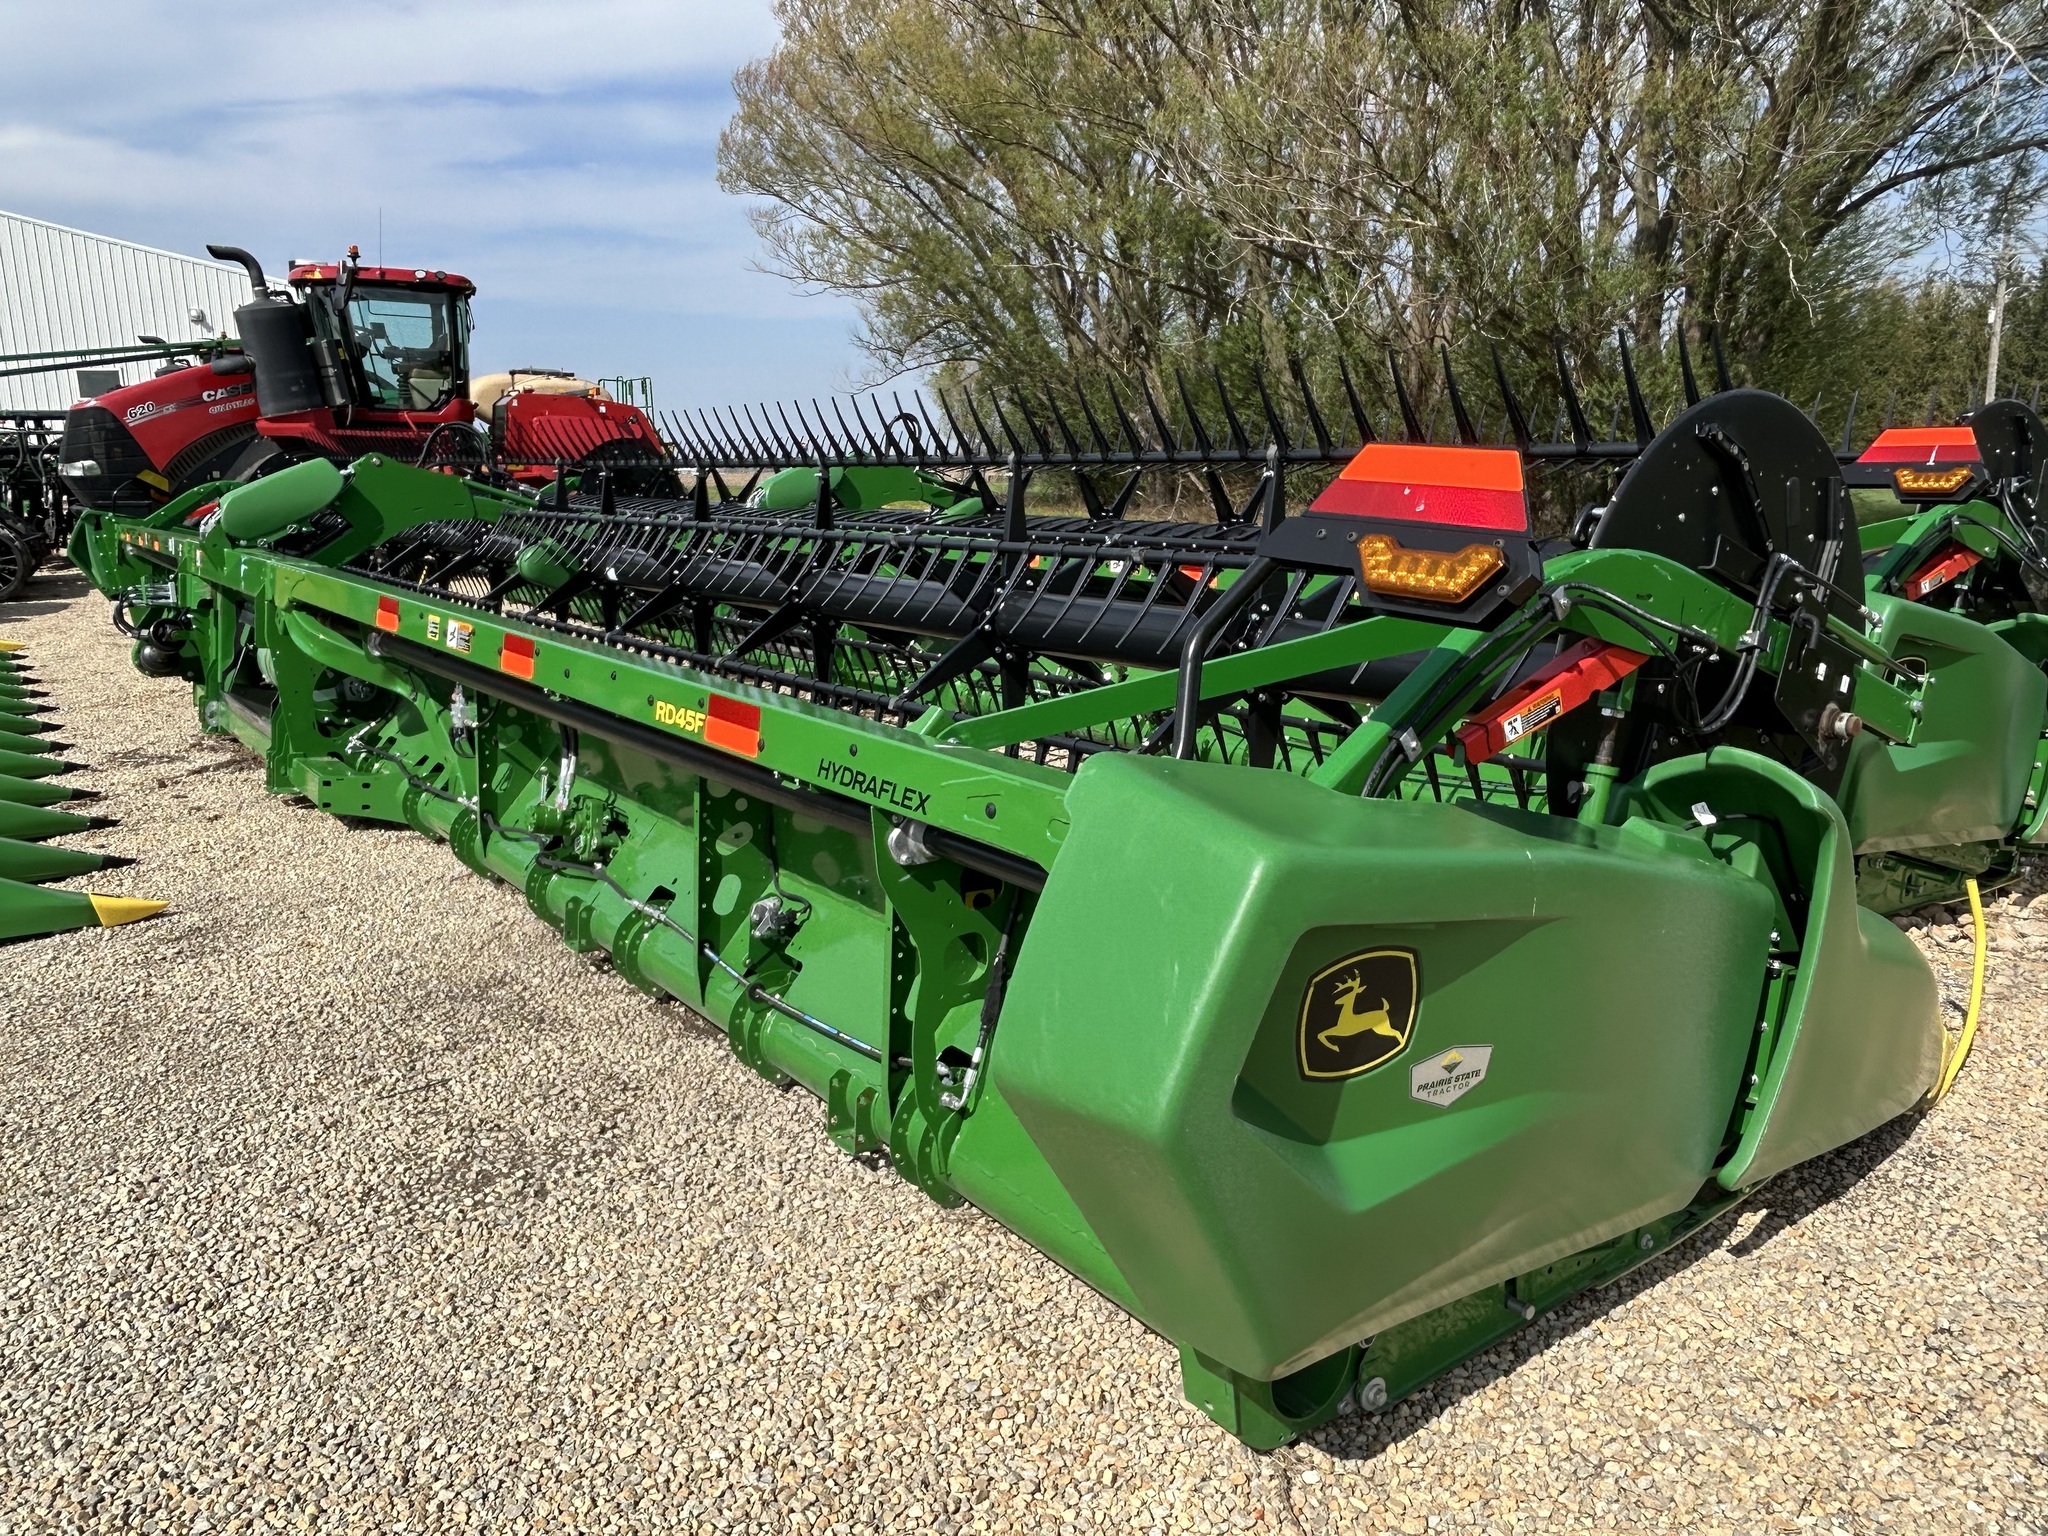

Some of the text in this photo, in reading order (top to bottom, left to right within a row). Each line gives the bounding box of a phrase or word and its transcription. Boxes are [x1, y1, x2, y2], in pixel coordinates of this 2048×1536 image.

[202, 382, 252, 402] CASE
[128, 402, 156, 419] 620
[655, 700, 706, 733] RD45F
[817, 758, 931, 816] HYDRAFLEX
[1416, 1069, 1481, 1093] PRAIRIE STATE
[1427, 1081, 1470, 1098] TRACTOR
